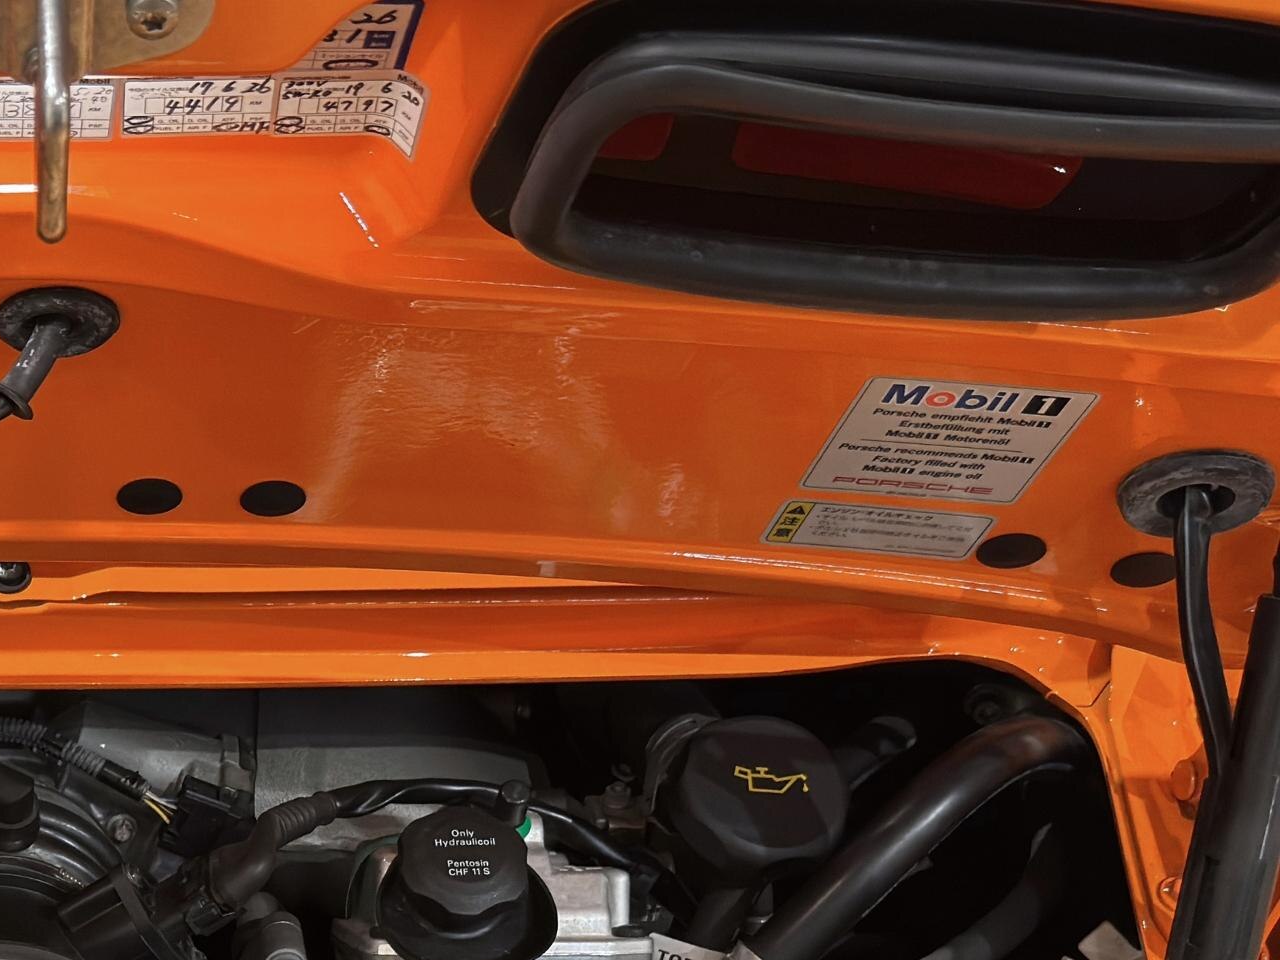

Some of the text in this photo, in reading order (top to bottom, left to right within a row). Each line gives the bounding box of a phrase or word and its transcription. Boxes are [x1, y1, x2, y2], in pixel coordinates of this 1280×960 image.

[880, 383, 1020, 413] Mobil
[872, 407, 927, 419] Porsche
[987, 428, 1010, 436] mit
[943, 434, 1011, 446] Motorenöl
[838, 443, 892, 452] Porsche
[894, 448, 979, 460] recommends
[872, 455, 986, 471] Factory filled with
[918, 468, 962, 478] engine
[832, 476, 994, 496] PORSCHE
[451, 829, 474, 838] Only
[434, 838, 496, 847] Hydraulicoil
[447, 859, 489, 868] Pentosin
[448, 867, 491, 876] CHF 11 S
